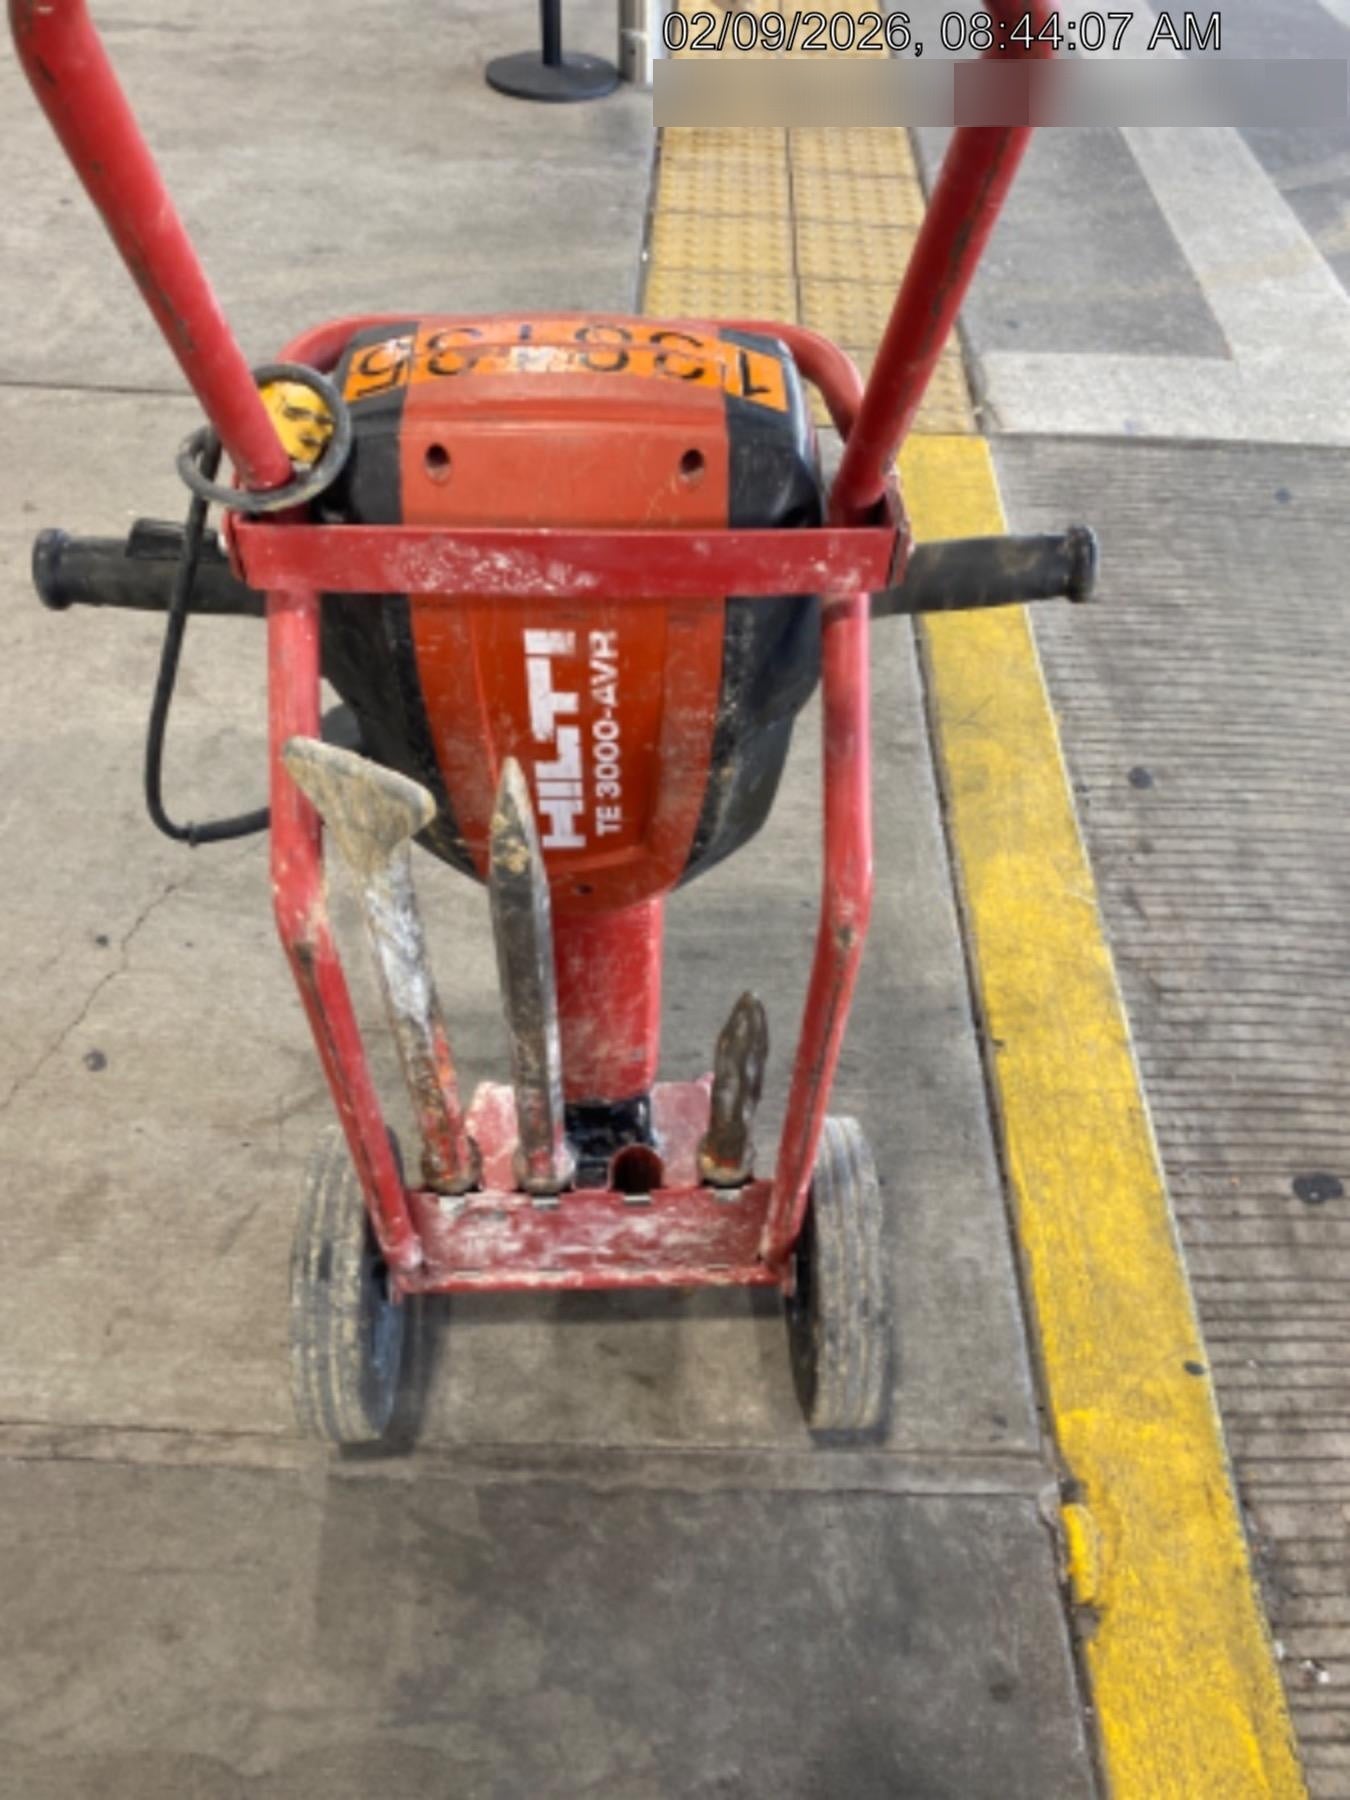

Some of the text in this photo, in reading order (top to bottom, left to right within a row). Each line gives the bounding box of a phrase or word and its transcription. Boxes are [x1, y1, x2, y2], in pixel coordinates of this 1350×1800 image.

[523, 629, 587, 849] HILTI
[588, 629, 622, 837] TE 3000-AVR
